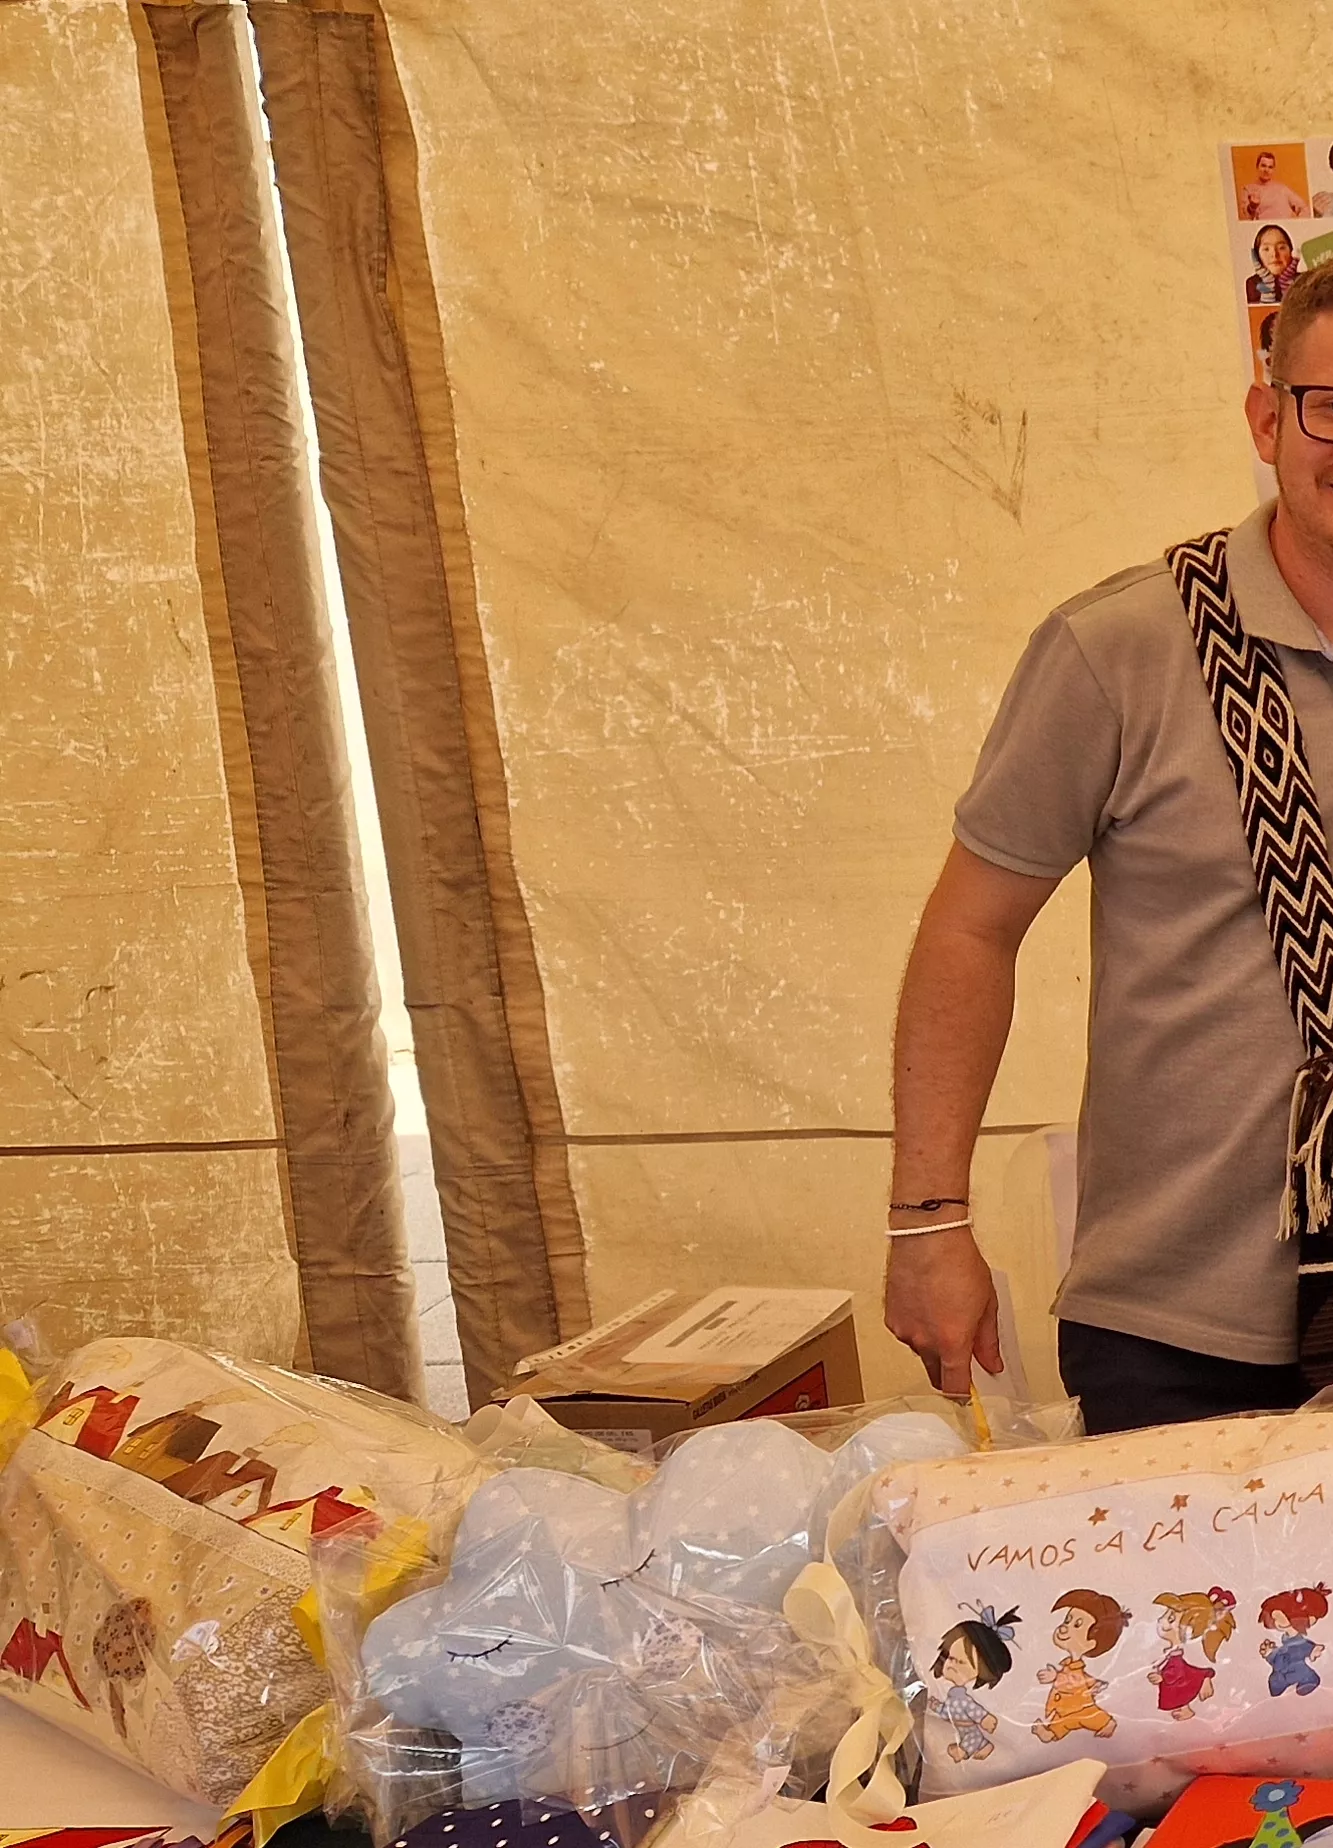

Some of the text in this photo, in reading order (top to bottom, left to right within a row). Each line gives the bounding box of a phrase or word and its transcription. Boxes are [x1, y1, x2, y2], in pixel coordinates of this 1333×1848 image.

[967, 1482, 1325, 1572] VAMOS A LA CAMA
